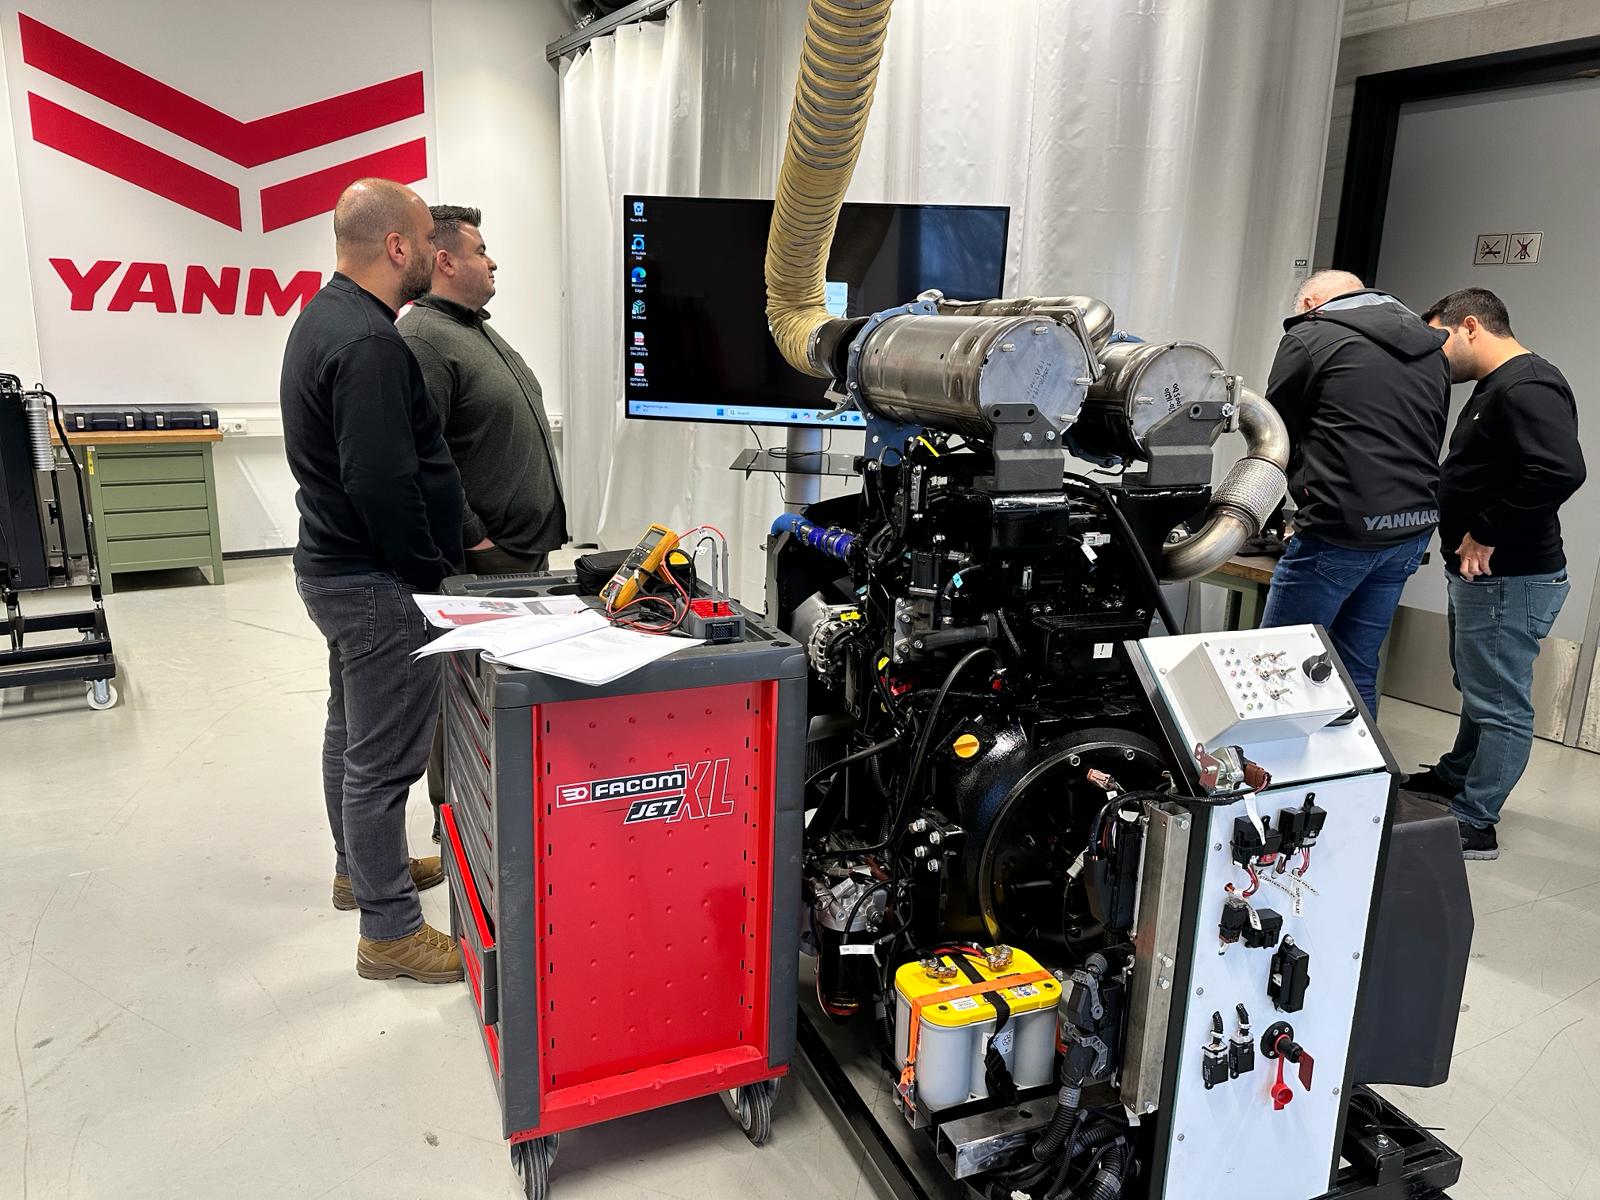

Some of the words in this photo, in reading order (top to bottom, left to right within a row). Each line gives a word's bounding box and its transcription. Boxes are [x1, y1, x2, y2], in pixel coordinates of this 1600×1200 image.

[49, 258, 323, 317] YANM
[1363, 509, 1440, 531] YANMAR
[595, 773, 682, 797] FACOM
[630, 800, 678, 819] JET
